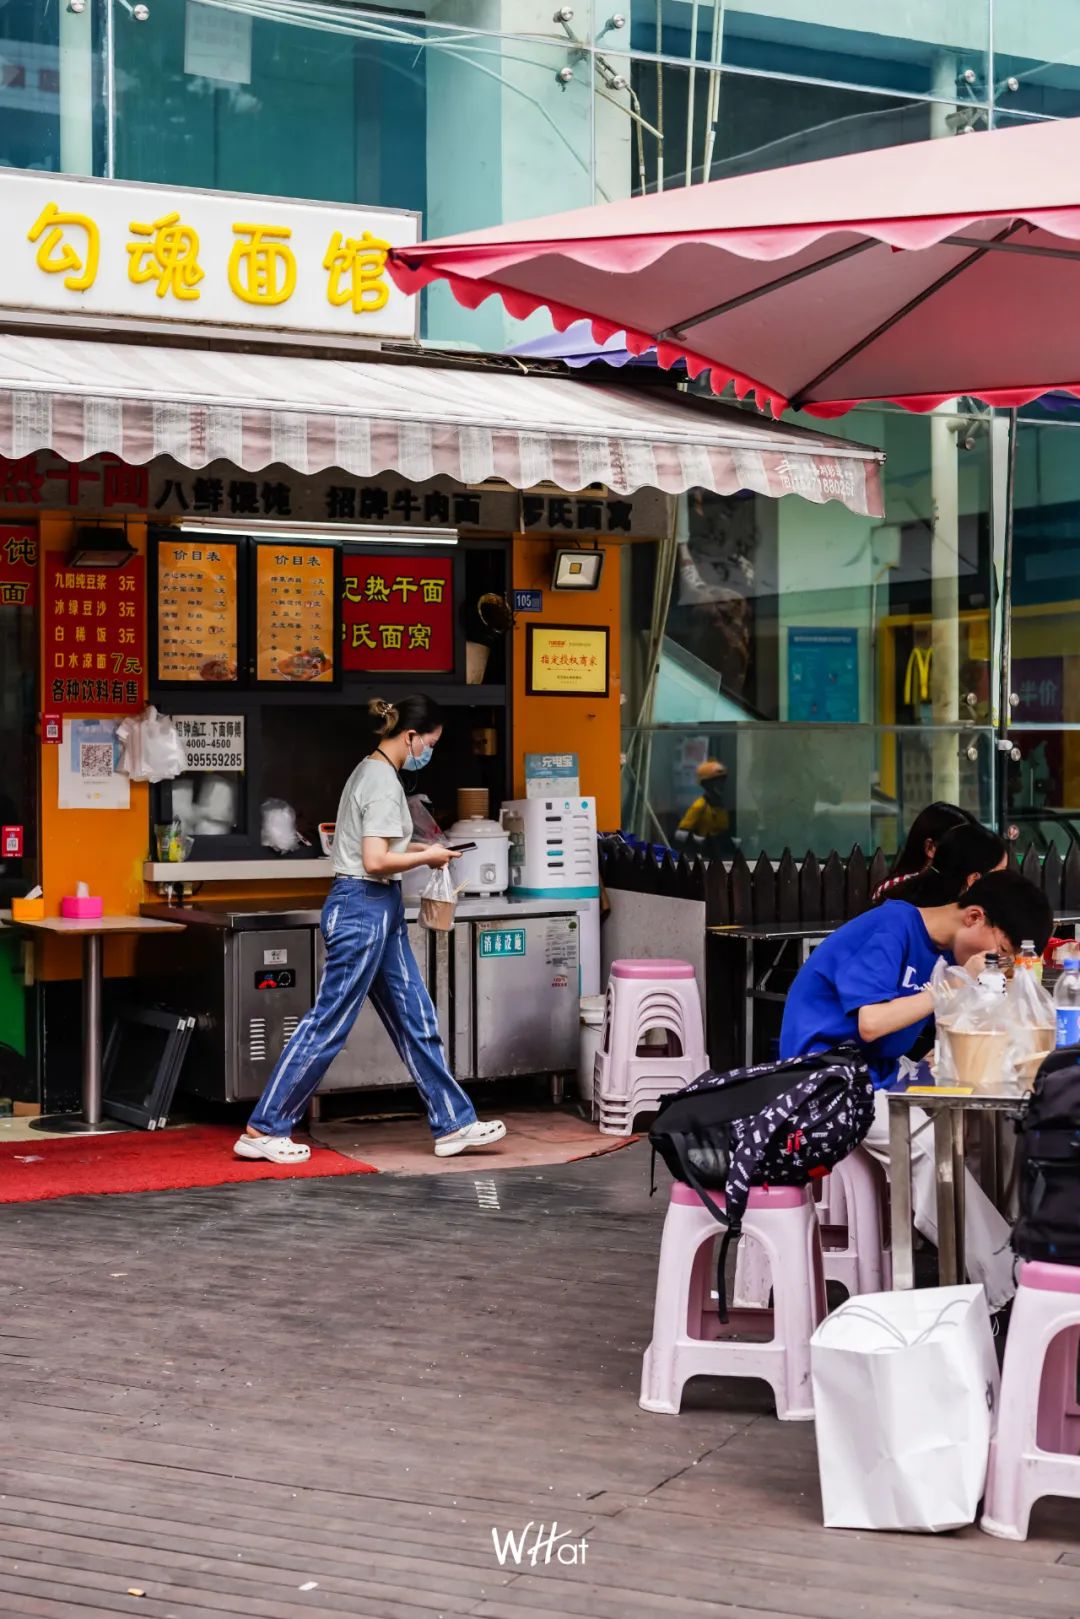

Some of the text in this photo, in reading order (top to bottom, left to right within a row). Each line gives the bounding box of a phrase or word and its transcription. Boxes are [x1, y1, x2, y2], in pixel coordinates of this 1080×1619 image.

[27, 202, 392, 313] 勾魂面馆
[155, 478, 292, 515] 八鲜馄饨
[326, 486, 482, 524] 招牌牛肉面
[174, 550, 220, 562] 价目表
[275, 555, 321, 567] 价目表
[55, 572, 135, 591] 九阳纯豆浆 3元
[55, 599, 135, 617] 冰绿豆沙 3元
[55, 625, 135, 643] 白稀饭 3元
[342, 623, 431, 650] 氏面窝
[55, 652, 142, 674] 口水凉面 7元
[540, 654, 598, 667] 指定授权商家
[52, 678, 138, 704] 各种饮料有售
[186, 739, 231, 749] 4000-4500
[187, 753, 242, 767] 995559285
[484, 933, 522, 953] 消毒设施
